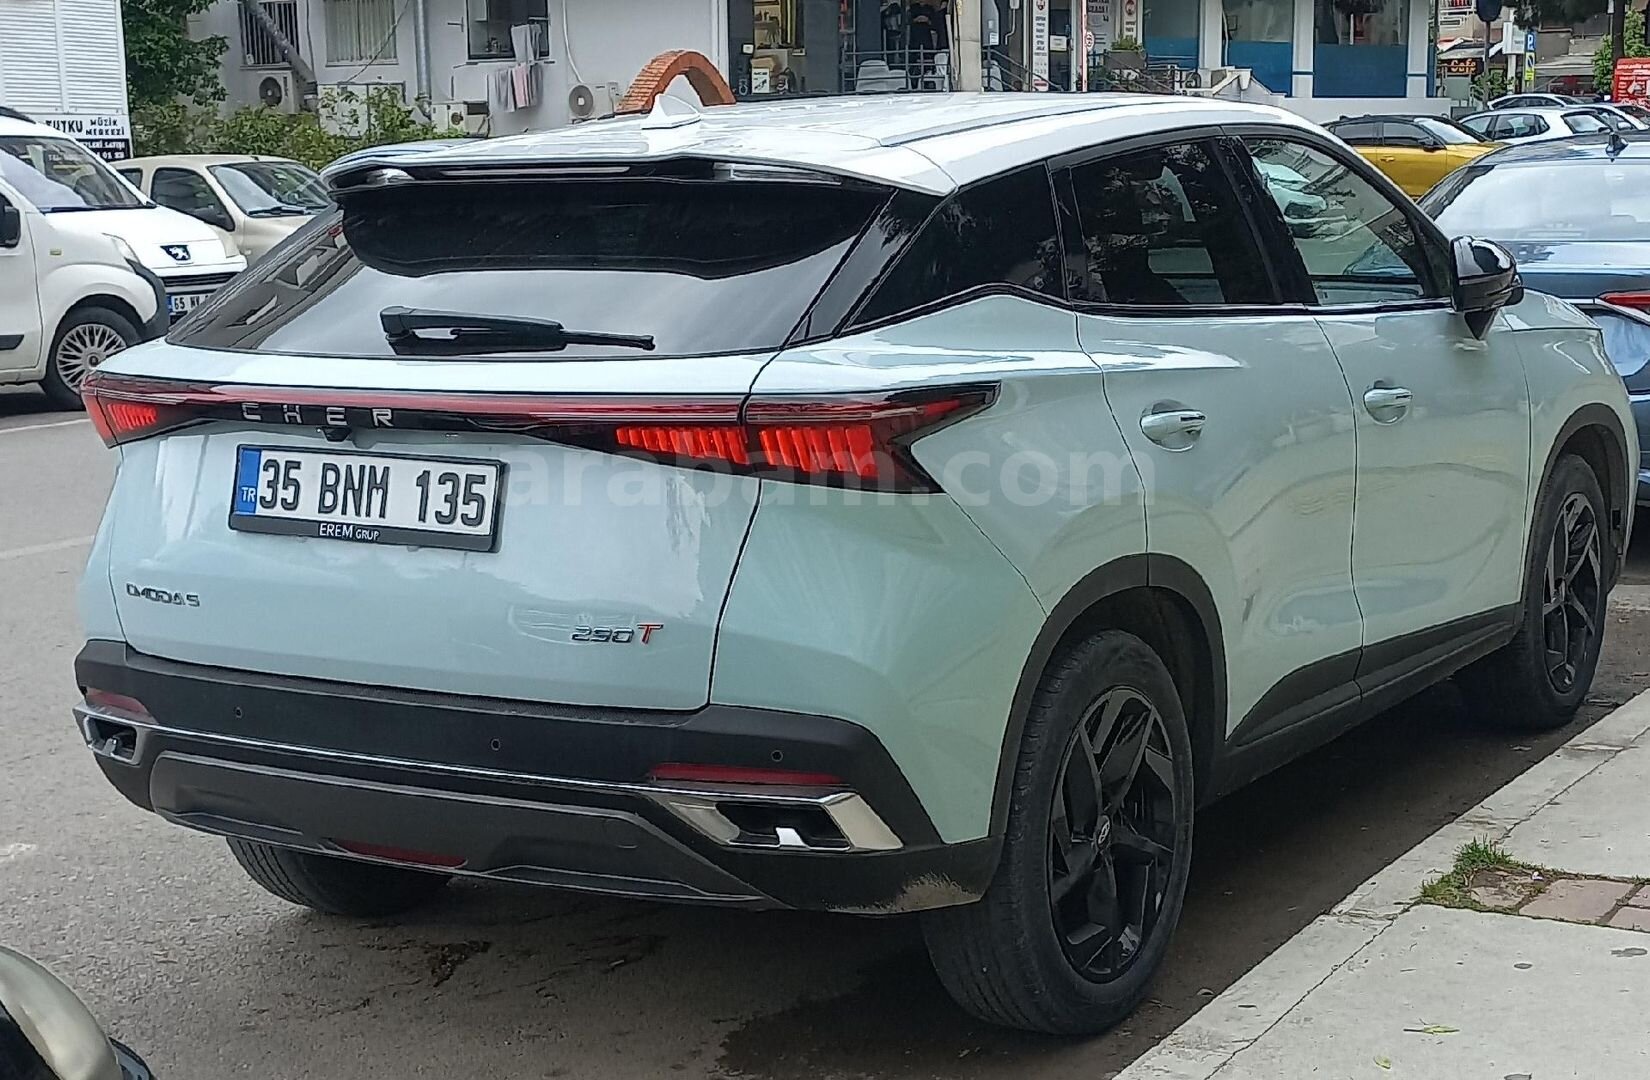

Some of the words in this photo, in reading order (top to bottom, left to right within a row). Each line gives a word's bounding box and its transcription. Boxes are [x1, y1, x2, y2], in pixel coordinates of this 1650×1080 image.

[241, 402, 394, 428] CHER
[241, 486, 256, 503] TR
[259, 459, 302, 511] 35
[318, 462, 390, 519] BNM
[416, 469, 487, 527] 135
[319, 523, 354, 538] EREM
[355, 528, 380, 540] GRUP
